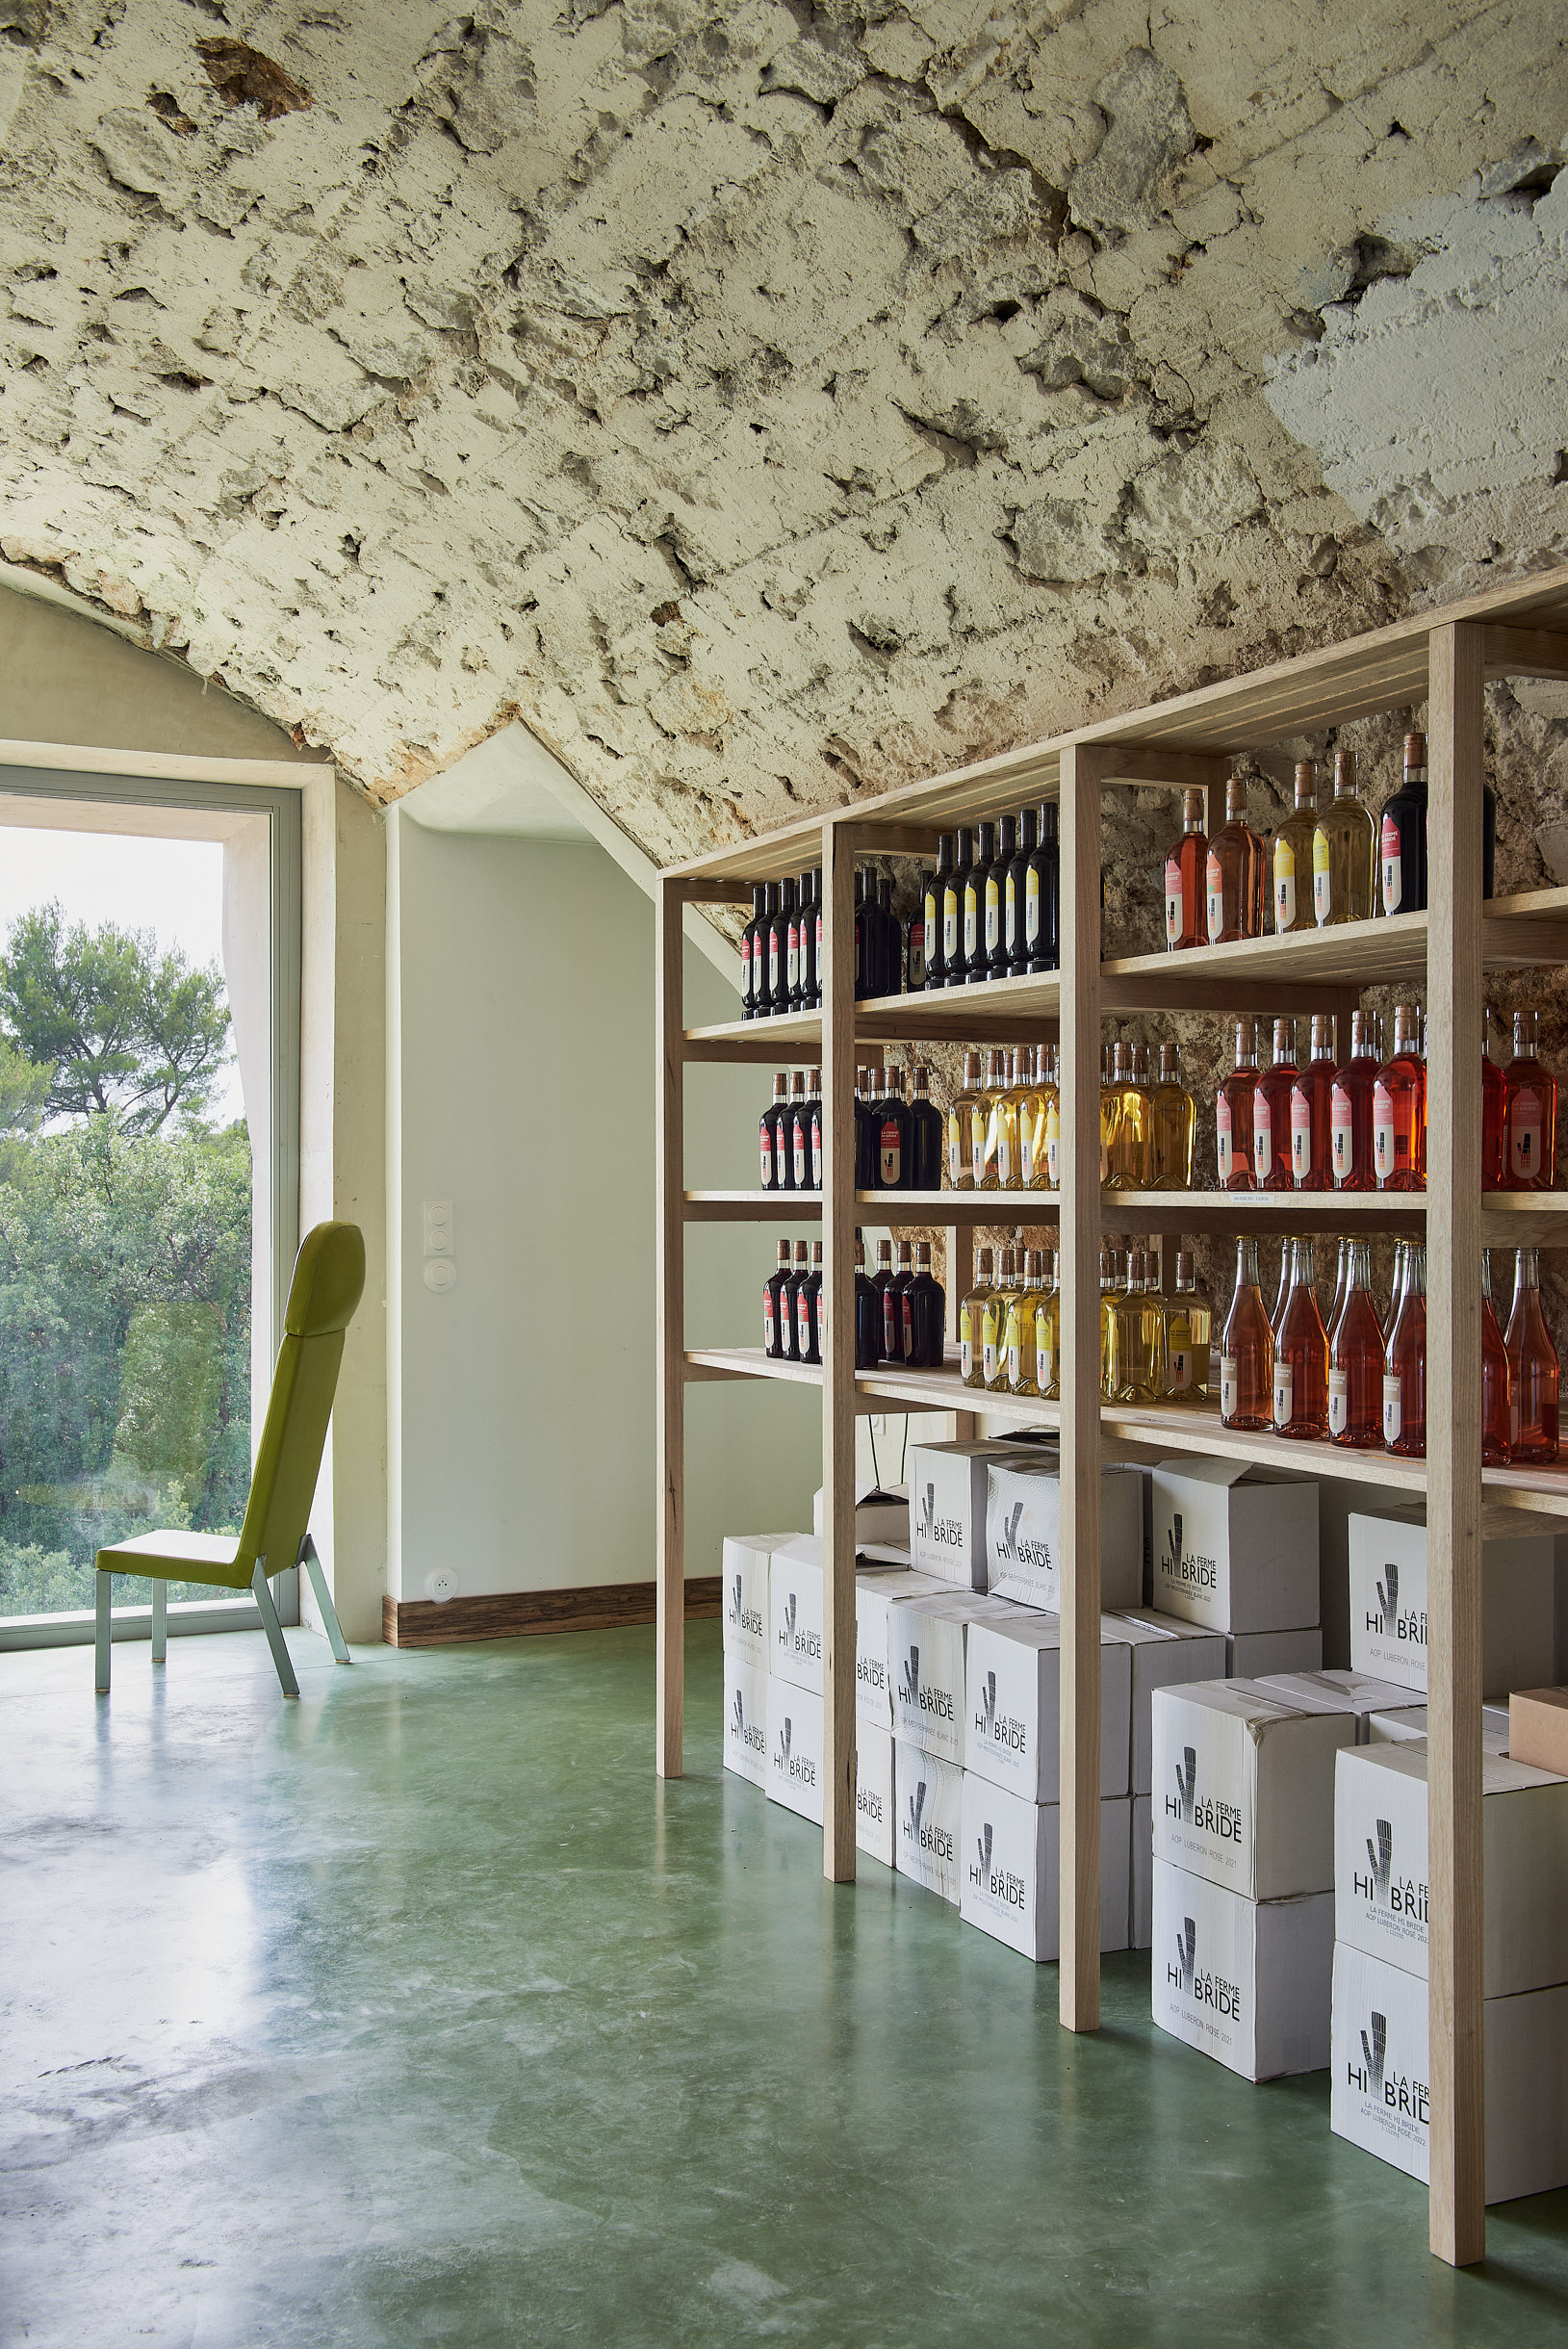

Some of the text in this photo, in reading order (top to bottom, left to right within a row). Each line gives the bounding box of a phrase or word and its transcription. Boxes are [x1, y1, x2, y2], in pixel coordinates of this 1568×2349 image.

[917, 1522, 963, 1547] HI BRIDE
[937, 1517, 962, 1531] LA FERME
[996, 1542, 1053, 1570] HI BRIDE
[1020, 1538, 1050, 1553] LA FERME
[1161, 1555, 1216, 1589] HI BRIDE
[1187, 1553, 1216, 1570] LA FERME
[729, 1608, 763, 1637] HI BRIDE
[1367, 1611, 1427, 1645] HI BRI
[1405, 1609, 1417, 1622] LA
[779, 1630, 788, 1646] HI
[795, 1636, 821, 1659] BRIDE
[807, 1630, 821, 1643] FERME
[860, 1656, 884, 1673] LA FERME
[1370, 1648, 1381, 1657] AOP
[1384, 1652, 1408, 1665] LUBERON
[857, 1663, 884, 1689] BRIDE
[899, 1685, 911, 1704] HI
[920, 1693, 954, 1721] BRIDE
[923, 1685, 953, 1704] LA FERME
[746, 1723, 764, 1739] LA FERME
[975, 1713, 986, 1734] HI
[995, 1722, 1026, 1754] BRIDE
[999, 1713, 1026, 1735] LA FERME
[731, 1722, 765, 1754] HI BRIDE
[774, 1752, 783, 1770] HI
[790, 1760, 815, 1786] BRIDE
[794, 1753, 815, 1771] LA FERME
[858, 1794, 882, 1823] BRIDE
[861, 1787, 882, 1806] LA FERME
[1201, 1795, 1241, 1821] LA FERME
[1166, 1794, 1242, 1843] HI BRIDE
[903, 1820, 913, 1840] HI
[921, 1830, 953, 1861] BRIDE
[925, 1822, 952, 1844] LA FERME
[1171, 1834, 1181, 1844] AOP
[1184, 1839, 1207, 1855] LUBERON
[970, 1864, 981, 1886] HI
[991, 1875, 1024, 1910] BRIDE
[996, 1866, 1025, 1891] LA FERME
[1399, 1876, 1414, 1894] LA
[1354, 1872, 1373, 1901] HI
[1391, 1886, 1429, 1923] BRI
[1377, 1917, 1400, 1932] LUBERON
[1378, 1909, 1396, 1922] FERME
[1398, 1917, 1405, 1926] HI
[1407, 1920, 1424, 1934] BRIDE
[1168, 1963, 1240, 2022] HI BRIDE
[1201, 1968, 1240, 2000] LA FERME
[1170, 2003, 1180, 2014] AOP
[1182, 2009, 1204, 2029] LUBERON
[1348, 2062, 1430, 2125] HI BRID
[1393, 2071, 1430, 2099] LA FER
[1361, 2107, 1371, 2117] AOP
[1372, 2113, 1396, 2131] LUBERON
[1413, 2134, 1426, 2146] 2022
[1365, 2100, 1372, 2110] LA
[1373, 2105, 1392, 2120] FERME
[1394, 2115, 1400, 2124] HI
[1402, 2119, 1420, 2134] BRIDE
